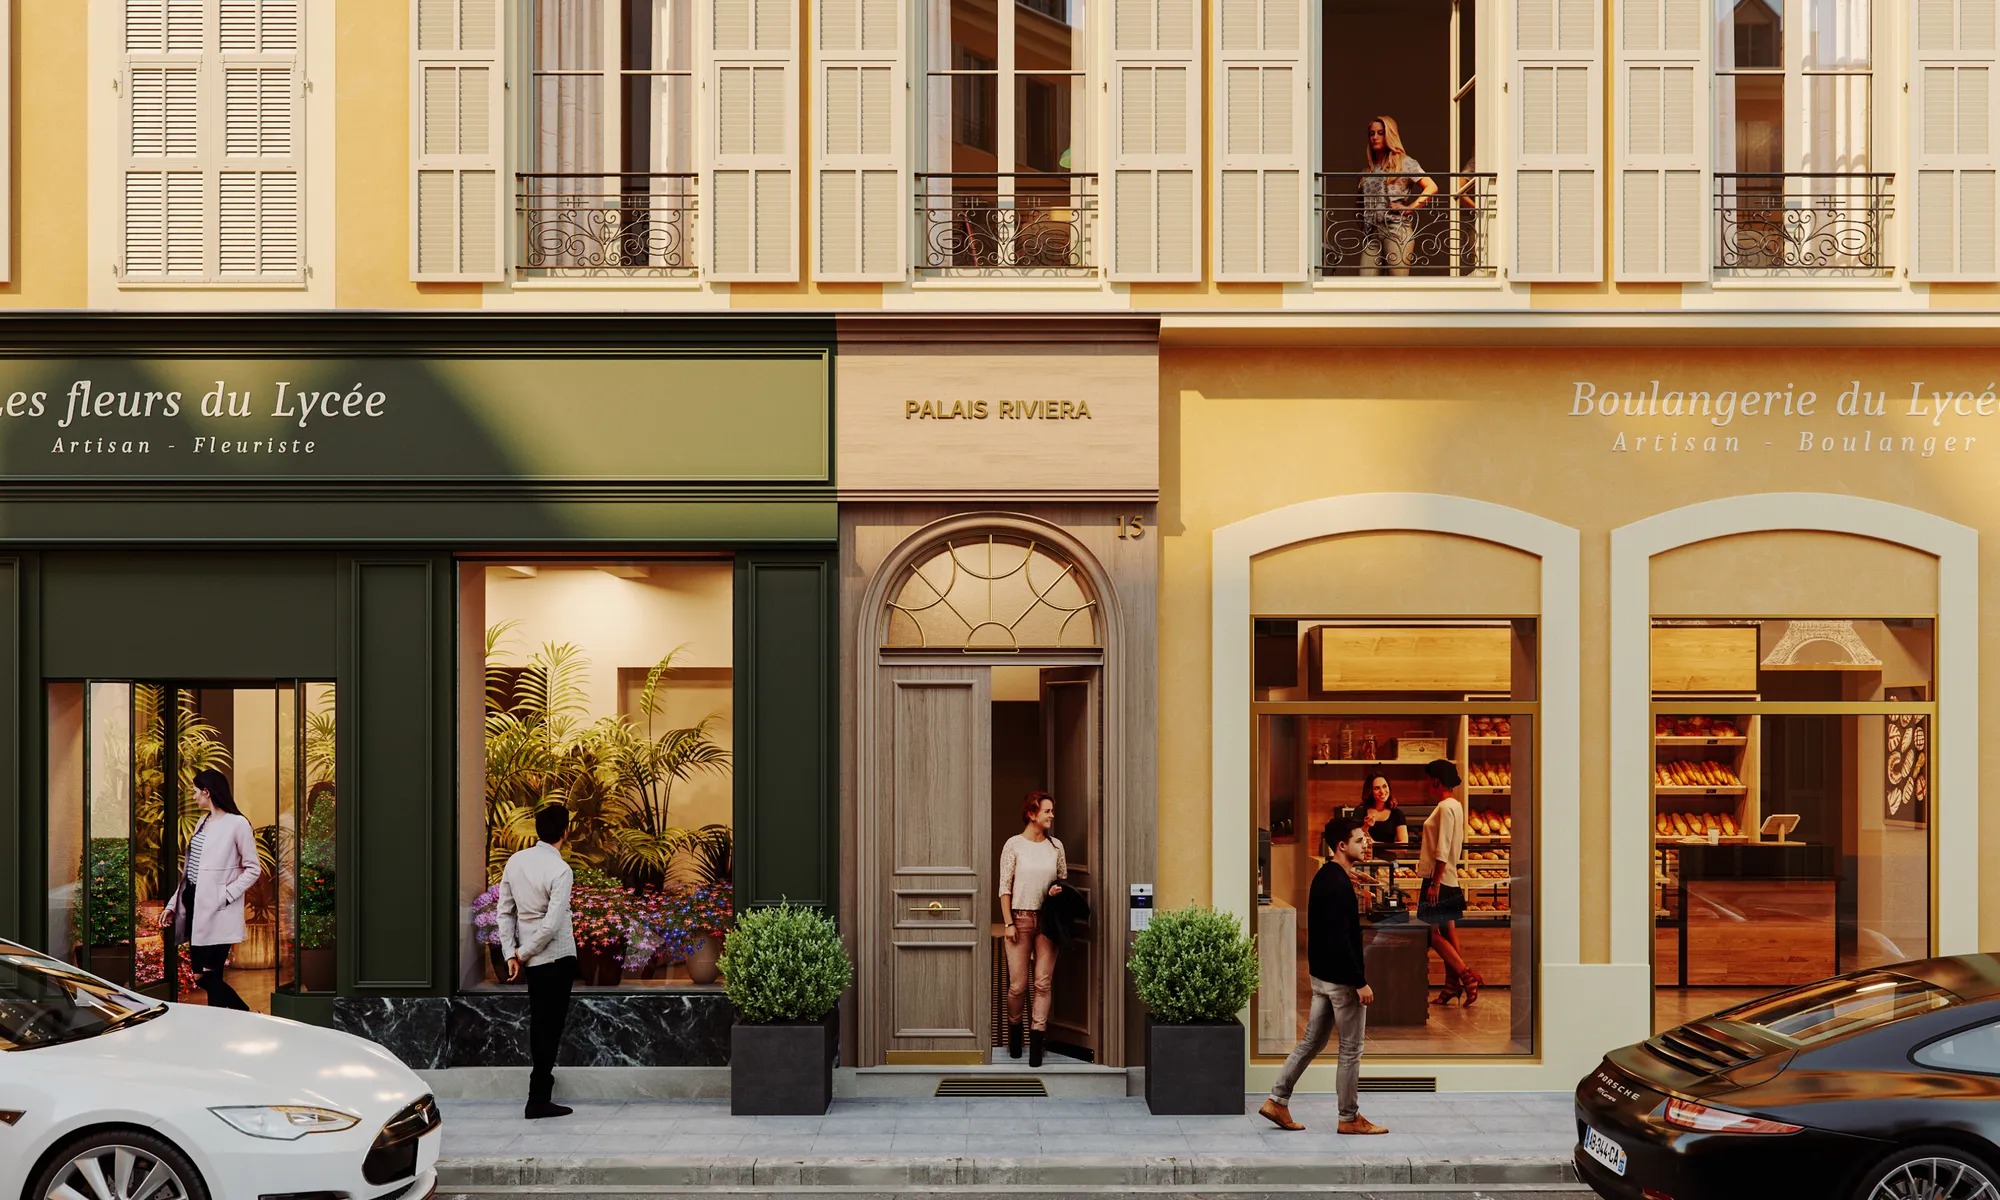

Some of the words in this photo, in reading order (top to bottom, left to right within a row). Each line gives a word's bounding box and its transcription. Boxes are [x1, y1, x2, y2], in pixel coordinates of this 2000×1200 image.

[0, 391, 48, 417] es
[57, 380, 182, 428] fleurs
[201, 381, 252, 417] du
[271, 382, 387, 428] Lycée
[905, 399, 989, 420] PALAIS
[999, 399, 1092, 420] RIVIERA
[1568, 380, 1817, 427] Boulangerie
[1837, 381, 1886, 416] du
[1905, 382, 2000, 427] Lycé
[51, 436, 150, 454] Artisan
[193, 436, 316, 454] Fleuriste
[1612, 431, 1740, 452] Artisan
[1799, 431, 1977, 458] Boulanger
[1117, 515, 1145, 538] 15
[1597, 1072, 1641, 1101] PORSCHE
